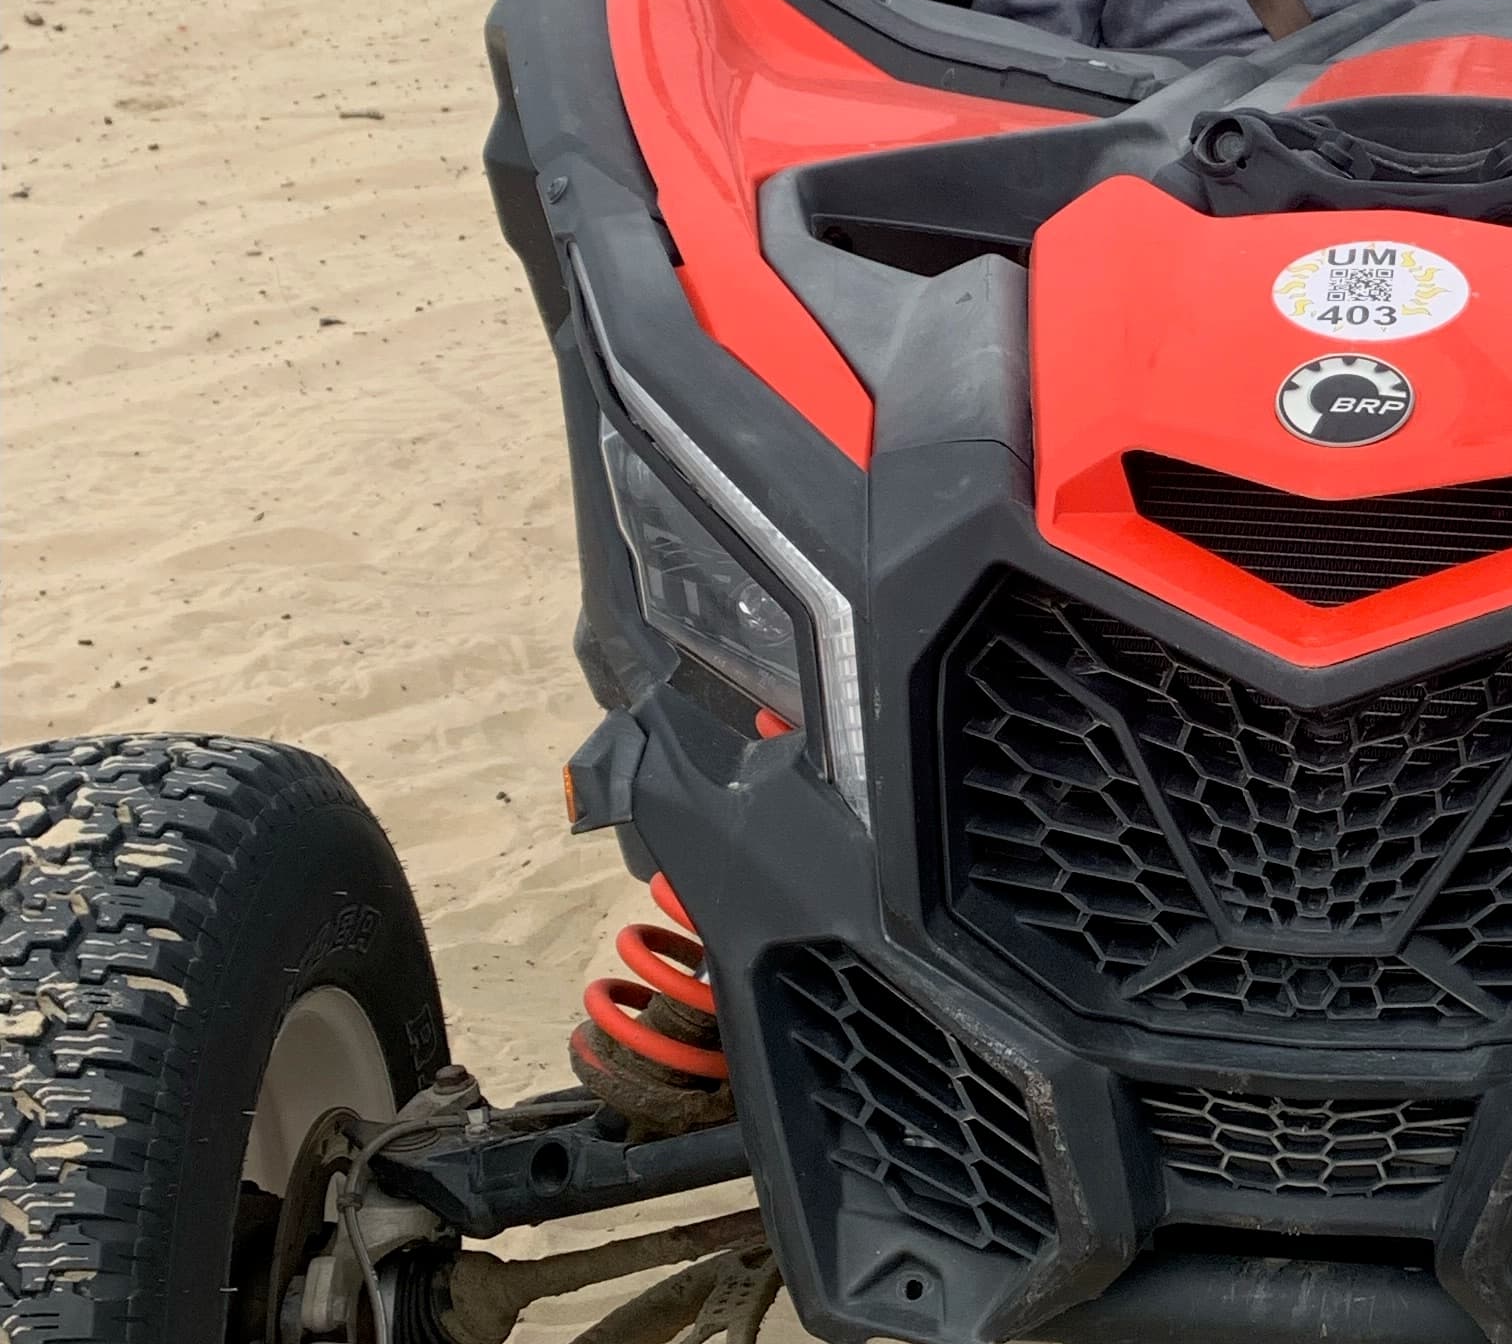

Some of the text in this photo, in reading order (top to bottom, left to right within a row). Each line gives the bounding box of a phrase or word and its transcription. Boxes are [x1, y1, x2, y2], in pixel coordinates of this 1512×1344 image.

[1327, 247, 1397, 266] UM
[1316, 305, 1398, 326] 403
[1329, 397, 1405, 415] BRP
